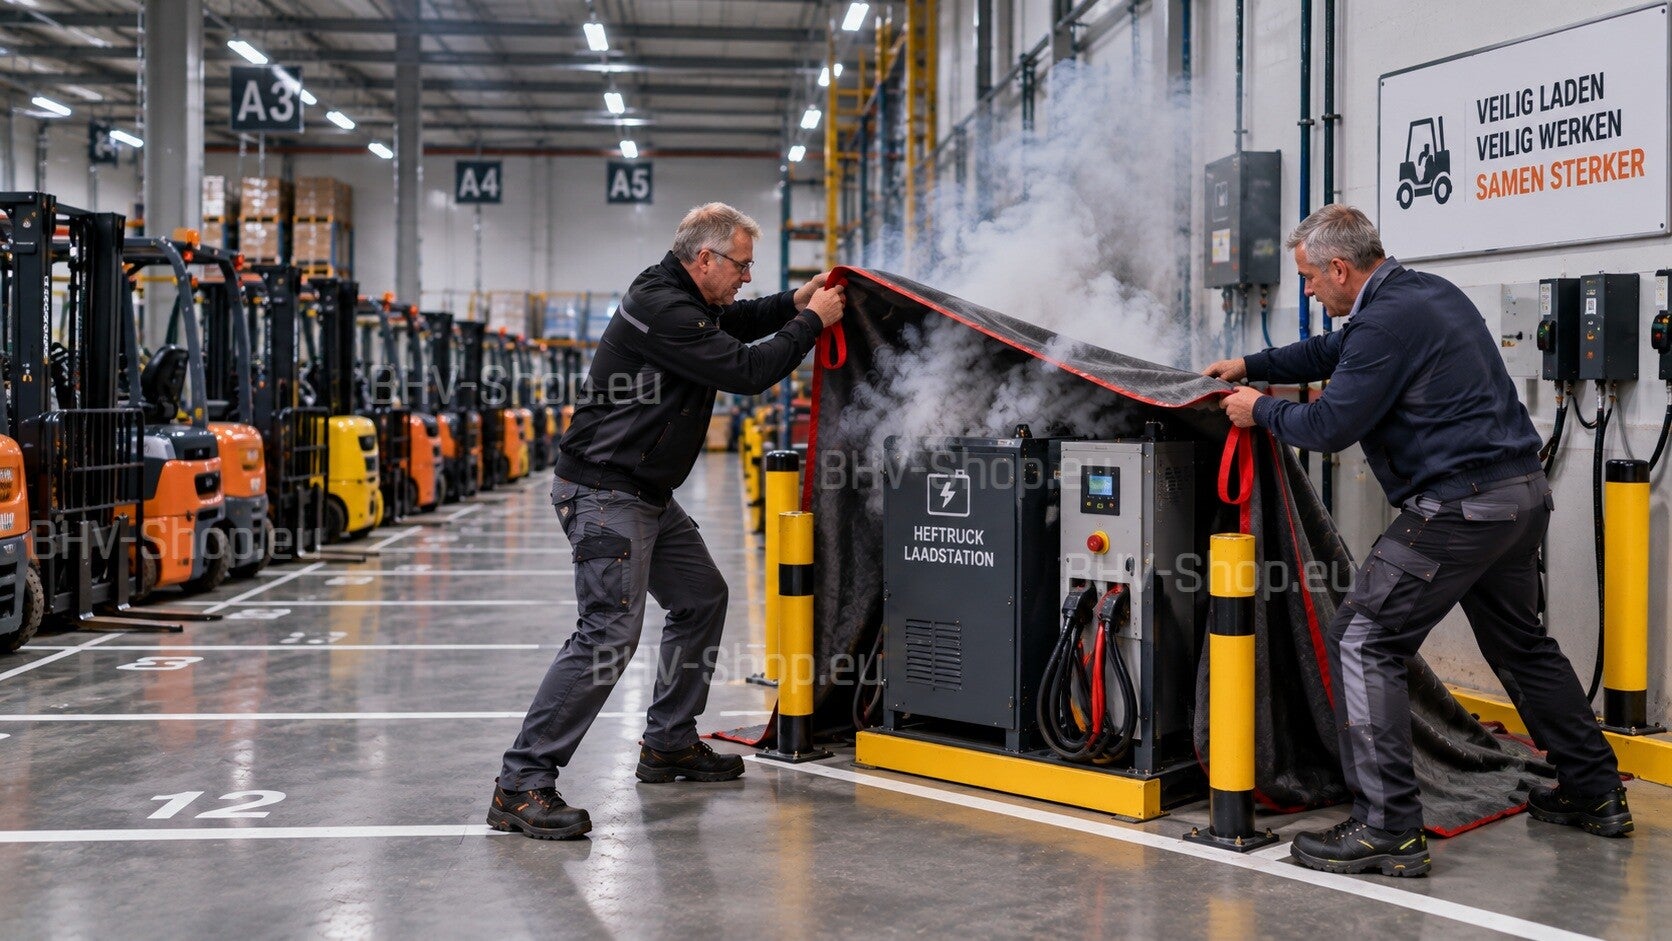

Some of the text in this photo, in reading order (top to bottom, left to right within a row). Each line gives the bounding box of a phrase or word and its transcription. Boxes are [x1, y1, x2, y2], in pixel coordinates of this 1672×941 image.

[237, 80, 295, 122] A3
[1477, 72, 1604, 124] VEILIG LADEN
[1477, 109, 1622, 161] VEILIG WERKEN
[459, 167, 498, 198] A4
[610, 168, 650, 198] A5
[1476, 148, 1645, 200] SAMEN STERKER
[914, 525, 985, 546] HEFTRUCK
[904, 545, 994, 568] LAADSTATION
[147, 789, 287, 819] 12
